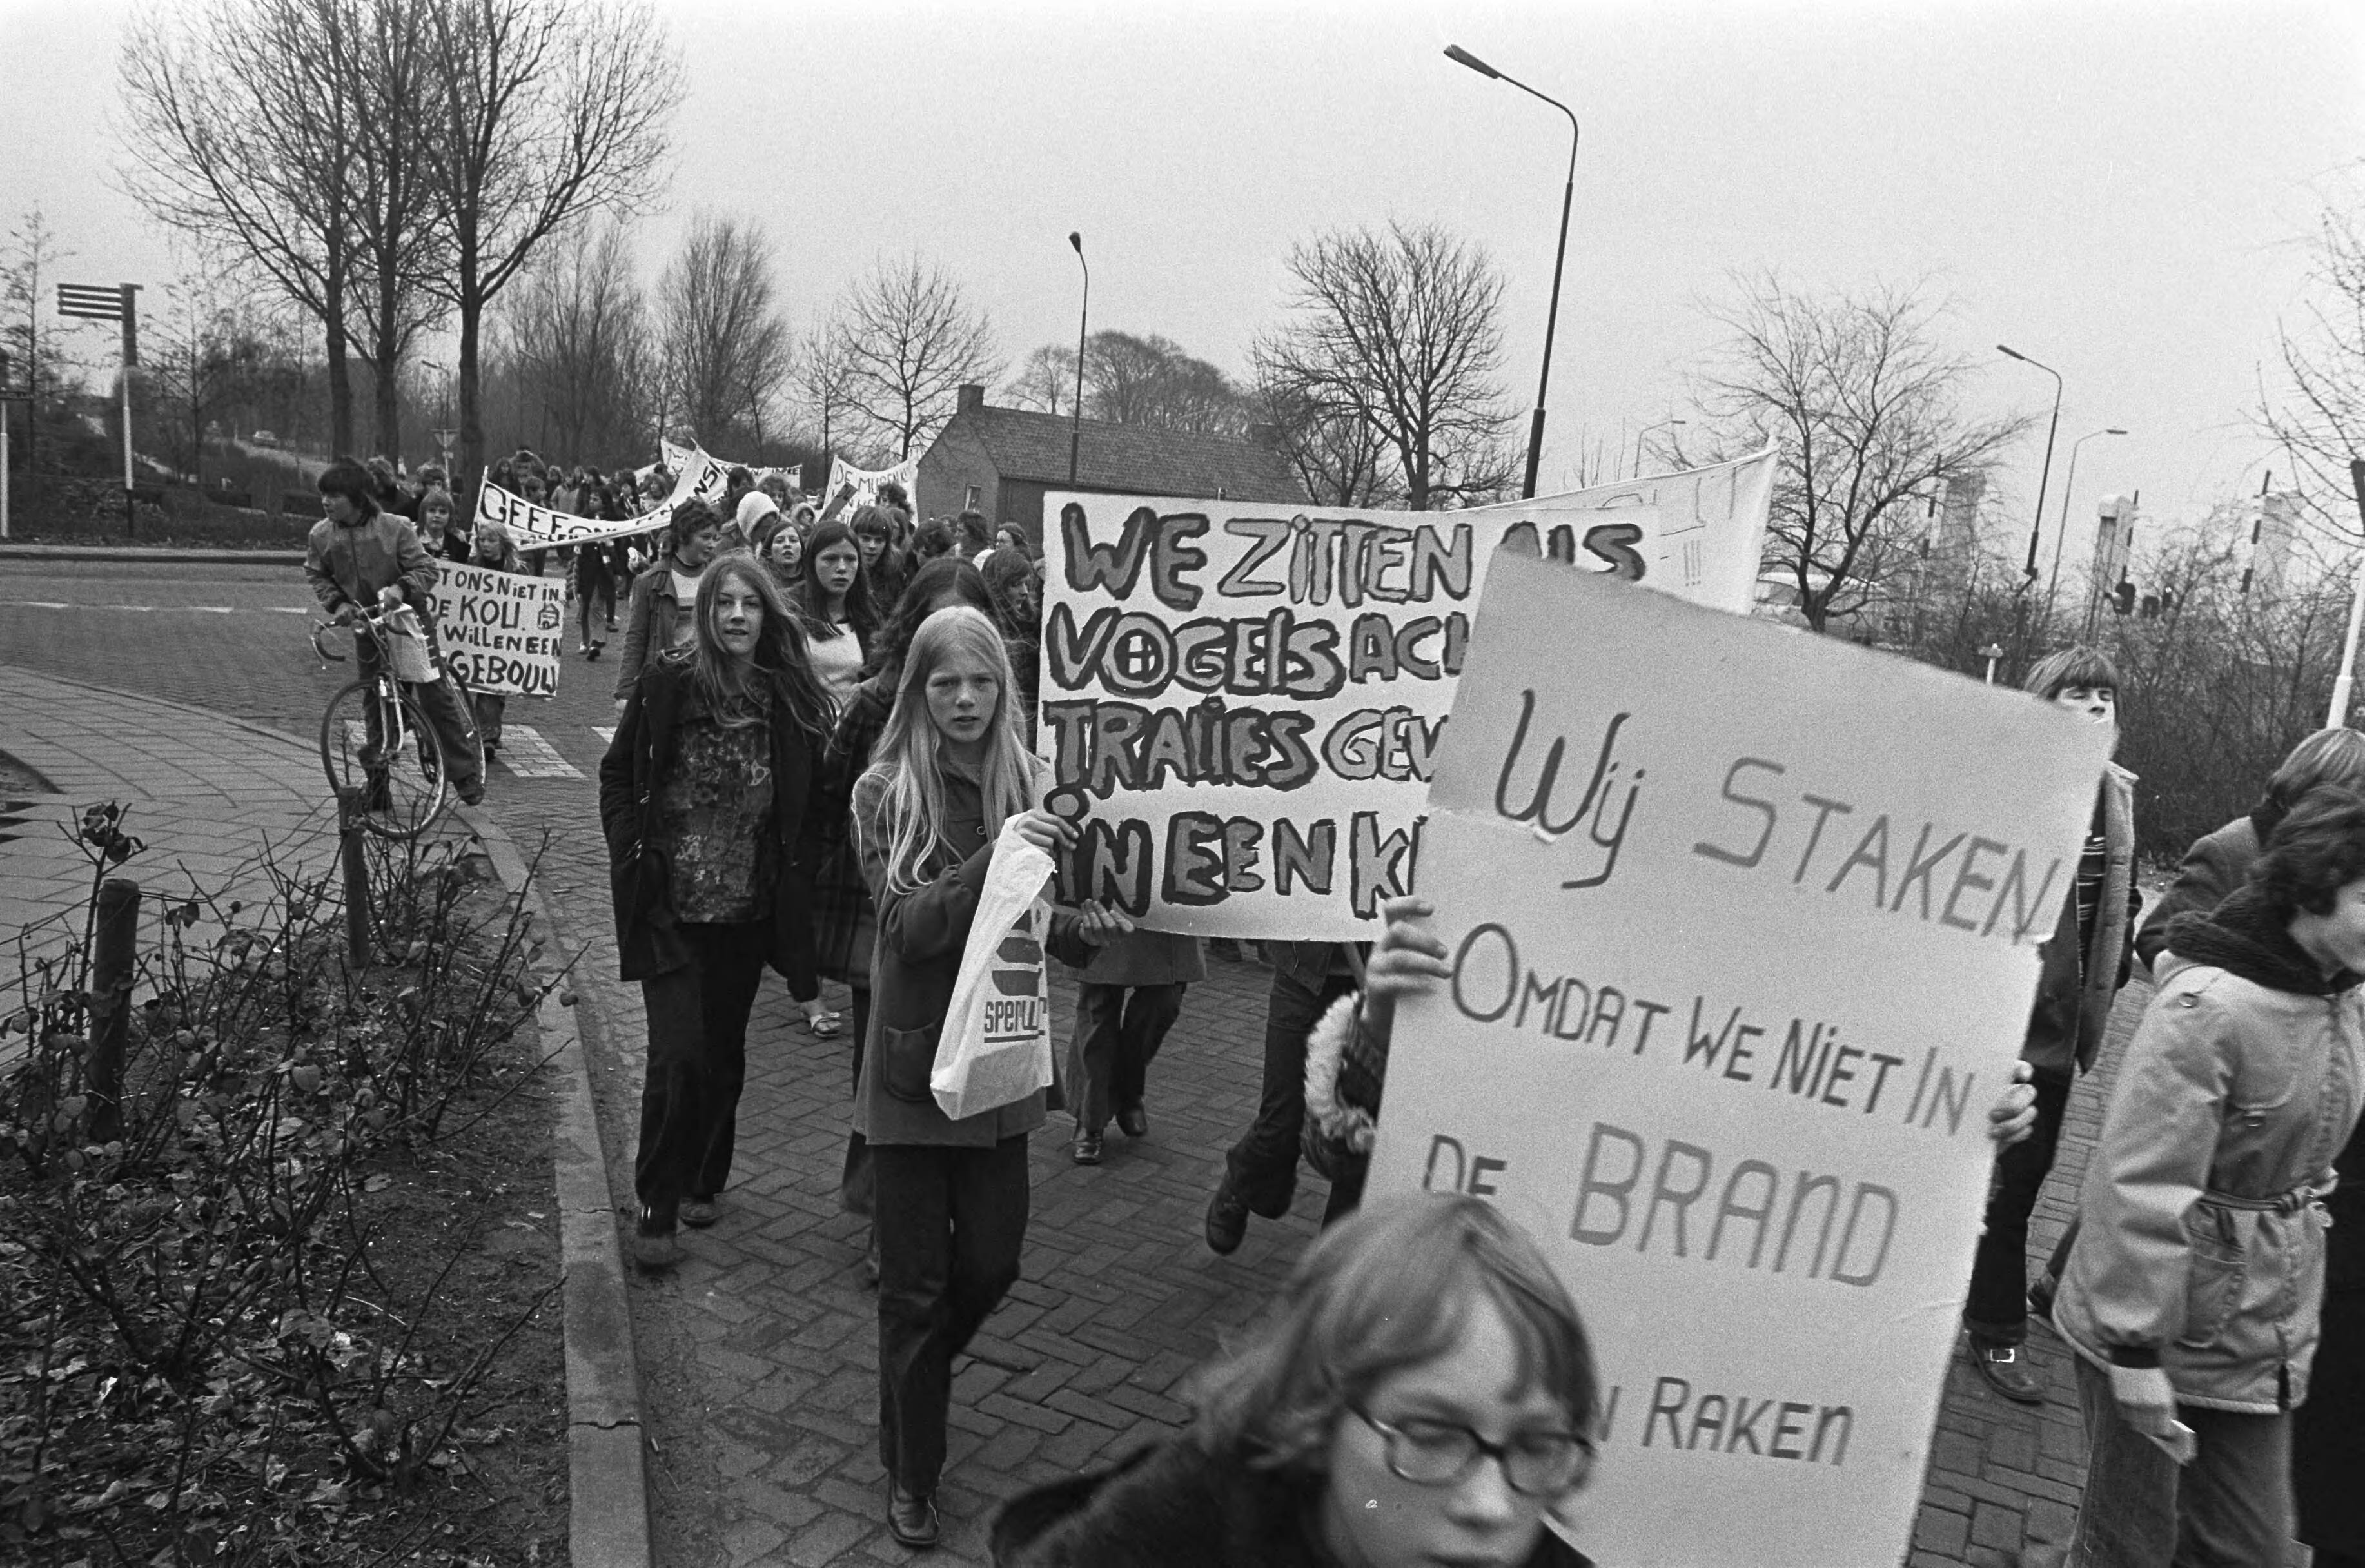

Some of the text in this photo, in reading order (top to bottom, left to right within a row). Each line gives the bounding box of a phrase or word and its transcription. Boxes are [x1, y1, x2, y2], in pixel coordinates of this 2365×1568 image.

[480, 484, 569, 535] GEEF
[455, 571, 494, 593] ONS
[1061, 502, 1210, 611] WE
[426, 592, 452, 618] DE
[448, 650, 556, 693] GEBOUW
[525, 636, 562, 657] EEN
[1161, 811, 1338, 906] EEN
[1693, 756, 2061, 945] STAKEN
[1682, 995, 1765, 1082] WE
[1904, 1046, 1975, 1136] IN
[1424, 1133, 1508, 1196] DE
